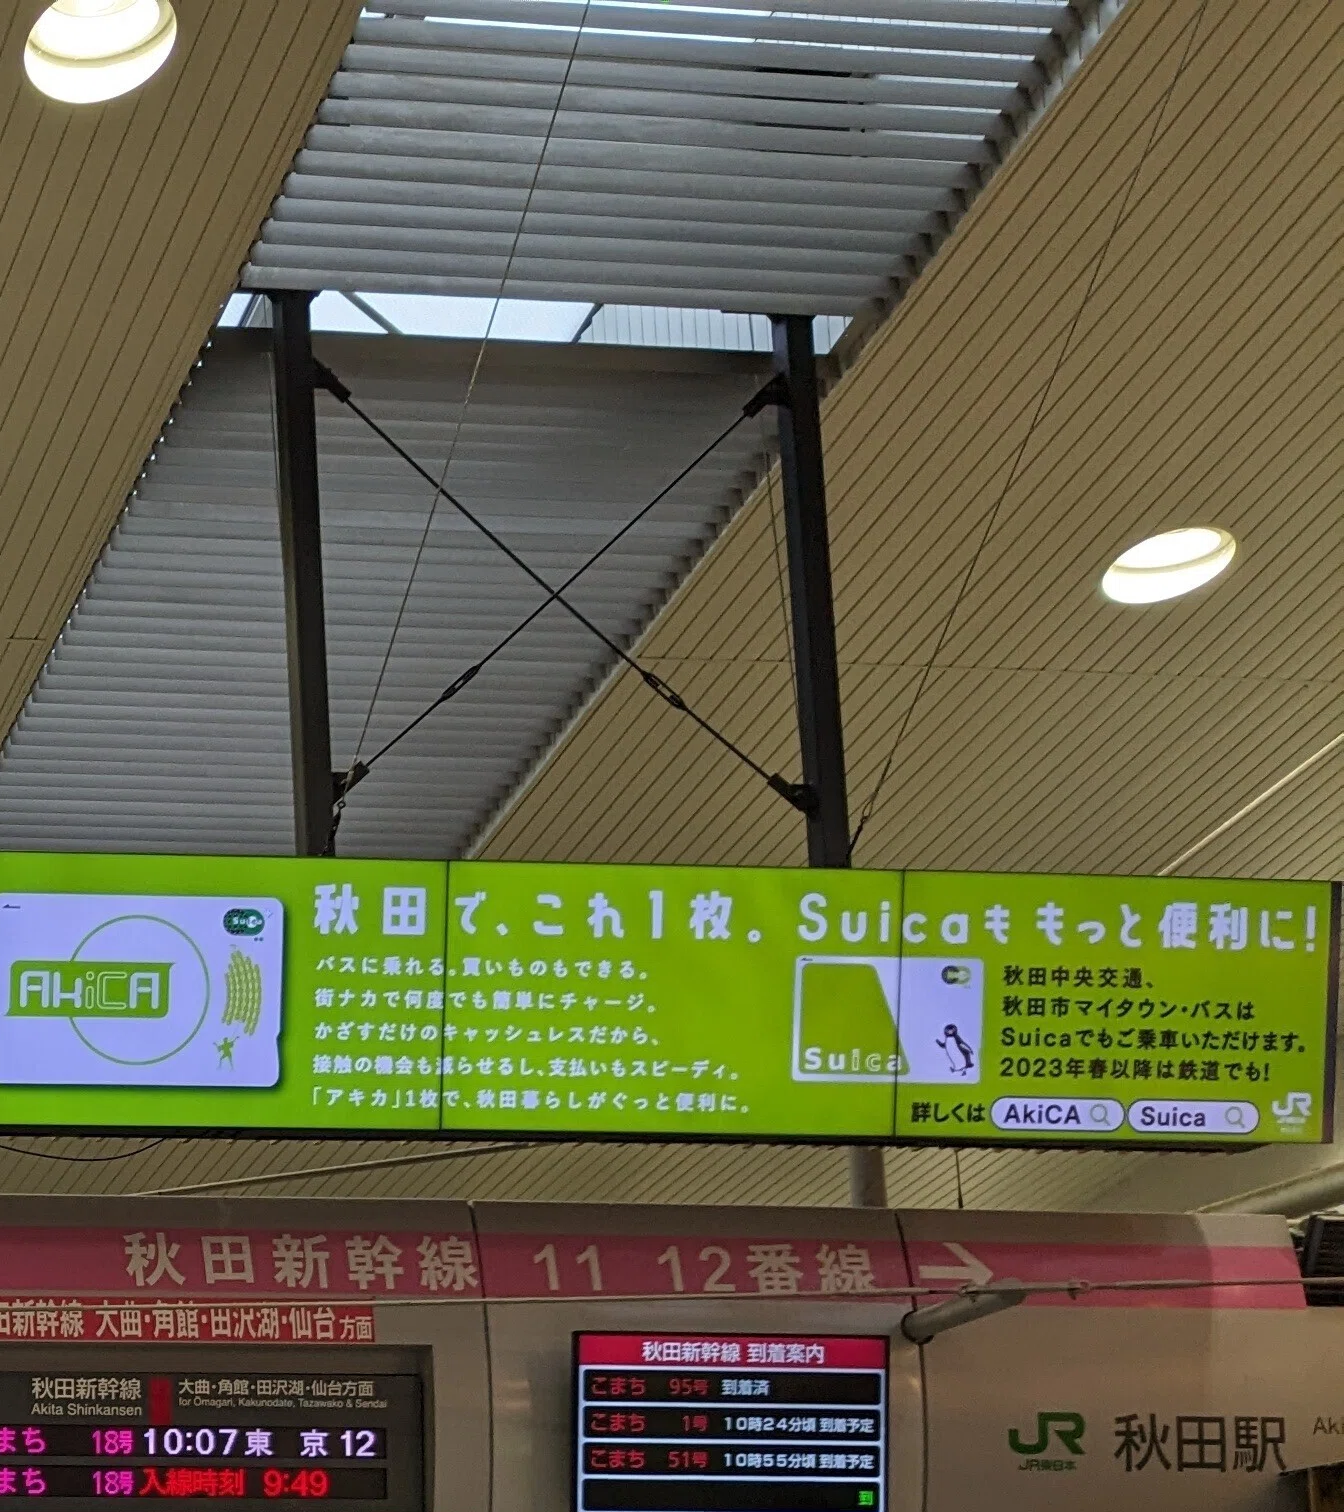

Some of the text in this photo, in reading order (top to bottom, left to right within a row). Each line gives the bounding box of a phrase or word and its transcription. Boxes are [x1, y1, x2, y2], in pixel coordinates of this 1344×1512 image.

[912, 1101, 1206, 1127] 詳しくは AkiCA Suica
[1272, 1091, 1312, 1116] JR
[125, 1232, 478, 1292] 秋田新幹線
[642, 1341, 825, 1364] 秋田新幹線 到着案内
[32, 1377, 142, 1401] 秋田新幹線
[31, 1402, 142, 1418] Akita Shinkansen
[92, 1429, 133, 1454] 18号
[143, 1429, 237, 1455] 10:07
[340, 1430, 376, 1457] 12
[1009, 1411, 1086, 1455] JR
[1114, 1413, 1287, 1473] 秋田駅
[92, 1471, 133, 1495] 18号
[263, 1471, 328, 1496] 9:49
